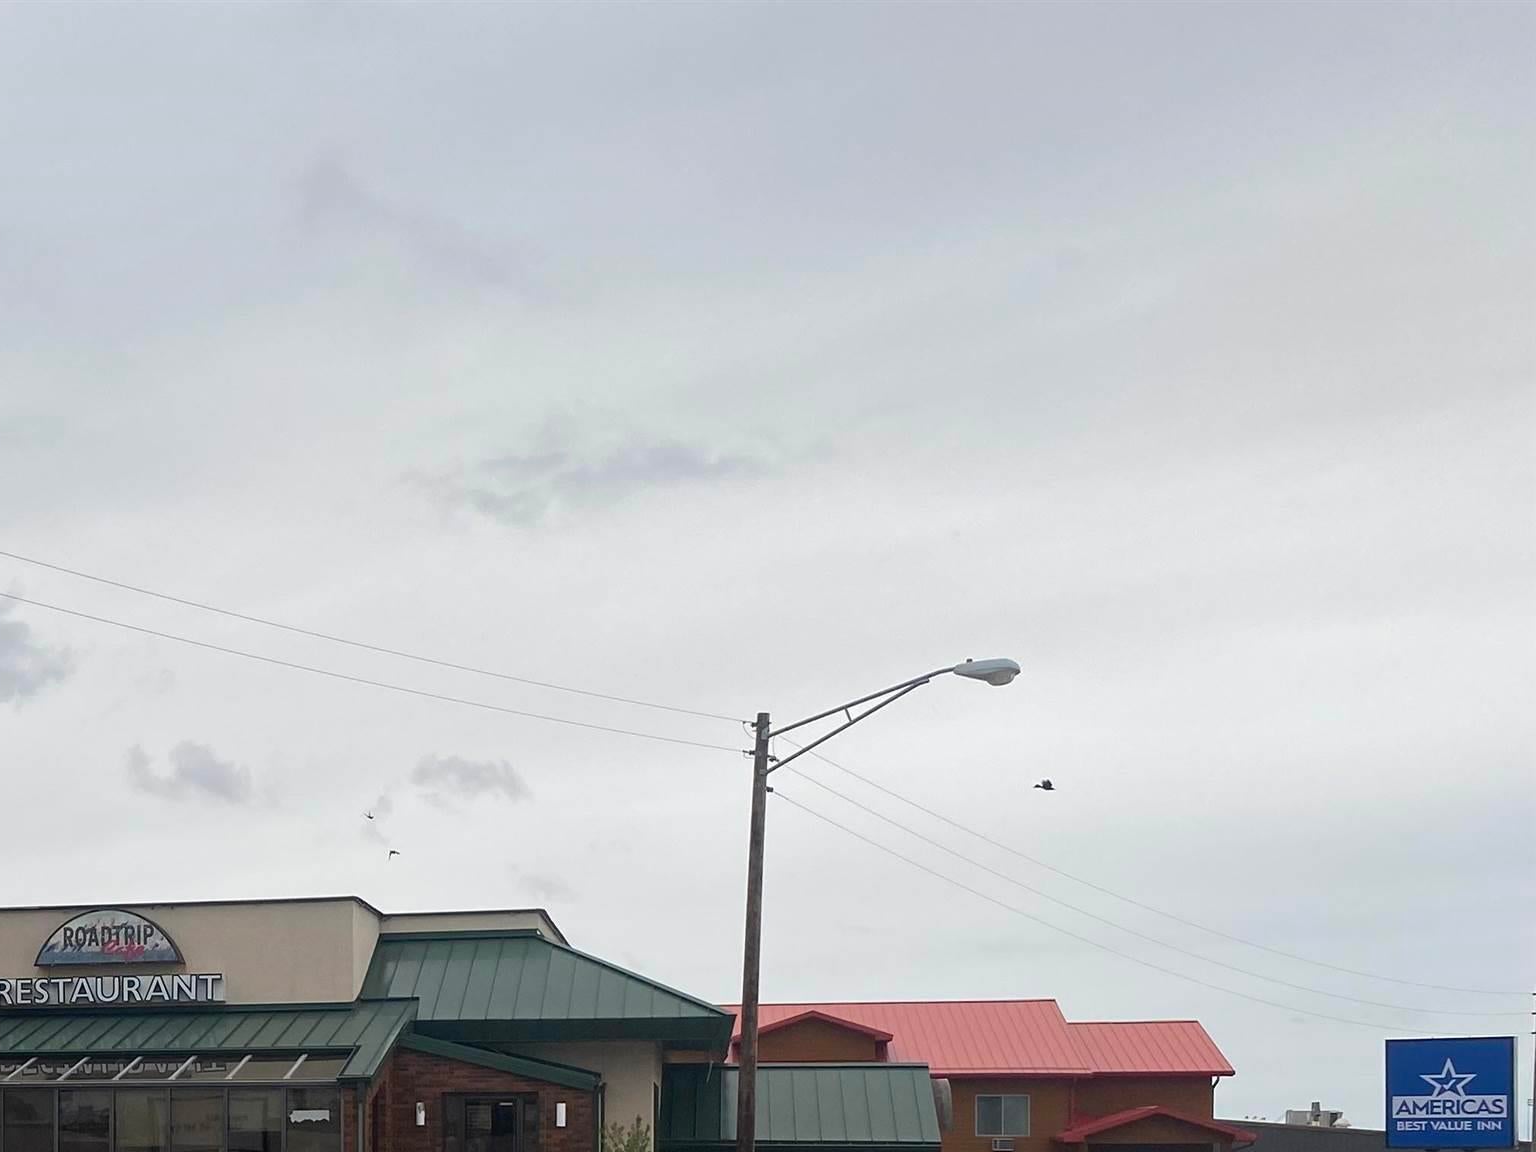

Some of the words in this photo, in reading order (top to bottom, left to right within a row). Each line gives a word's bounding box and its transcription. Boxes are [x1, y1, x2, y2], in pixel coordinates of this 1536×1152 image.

[63, 924, 155, 947] ROADTRIP
[1395, 1098, 1504, 1116] AMERICAS
[1396, 1120, 1428, 1131] BEST
[1430, 1120, 1473, 1131] VALUE
[1476, 1120, 1503, 1130] INN
